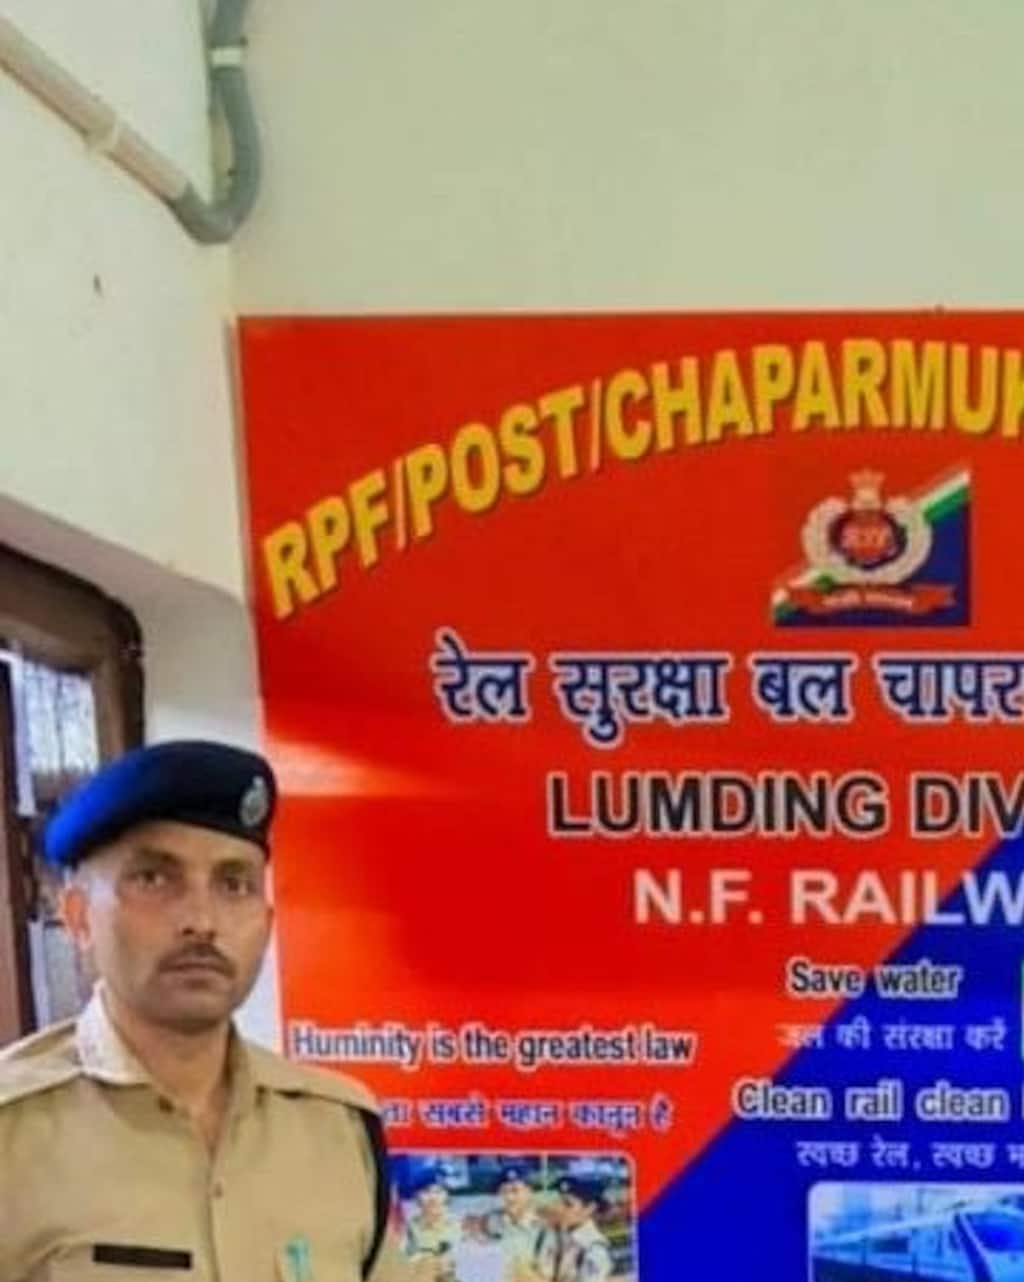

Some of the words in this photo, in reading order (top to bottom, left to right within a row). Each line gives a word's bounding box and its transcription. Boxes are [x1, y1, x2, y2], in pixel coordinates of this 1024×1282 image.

[429, 626, 533, 725] रेल
[551, 650, 732, 749] सुरक्षा
[750, 650, 857, 724] बल
[548, 771, 890, 839] LUMDING
[634, 869, 763, 925] N.F.
[789, 959, 863, 997] Save
[875, 962, 962, 998] water
[293, 1023, 420, 1067] Huminity
[432, 1023, 454, 1062] is
[464, 1023, 508, 1062] the
[516, 1024, 638, 1071] greatest
[645, 1025, 694, 1064] law
[837, 1016, 870, 1049] की
[419, 1092, 488, 1129] सबसे
[651, 1093, 672, 1134] है
[735, 1080, 829, 1121] Clean
[847, 1080, 901, 1121] rail
[918, 1080, 1009, 1121] clean
[797, 1142, 859, 1168] स्वच्छ
[934, 1142, 993, 1168] स्वच्छ
